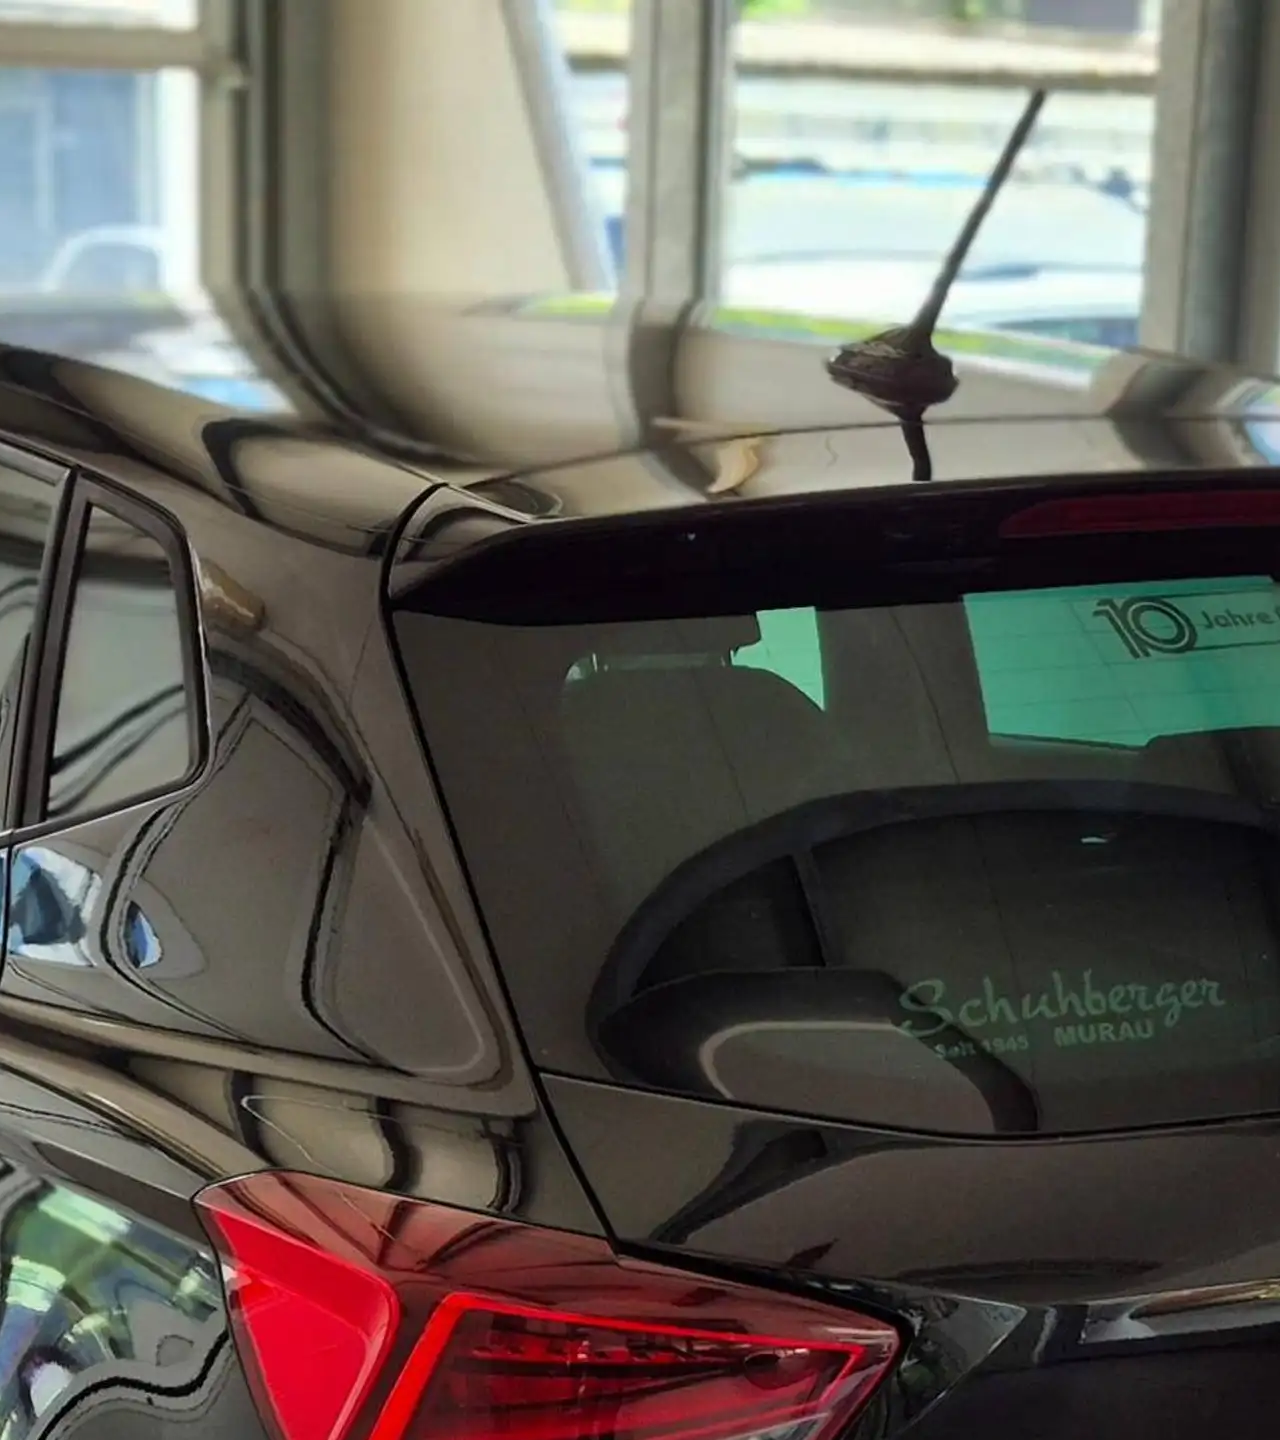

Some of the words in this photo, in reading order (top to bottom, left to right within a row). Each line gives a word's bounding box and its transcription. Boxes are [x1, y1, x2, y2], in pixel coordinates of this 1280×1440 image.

[1093, 594, 1199, 661] 10
[1200, 605, 1270, 632] Jahre
[899, 967, 1226, 1038] Schuhberger
[1054, 1018, 1157, 1049] MURAU
